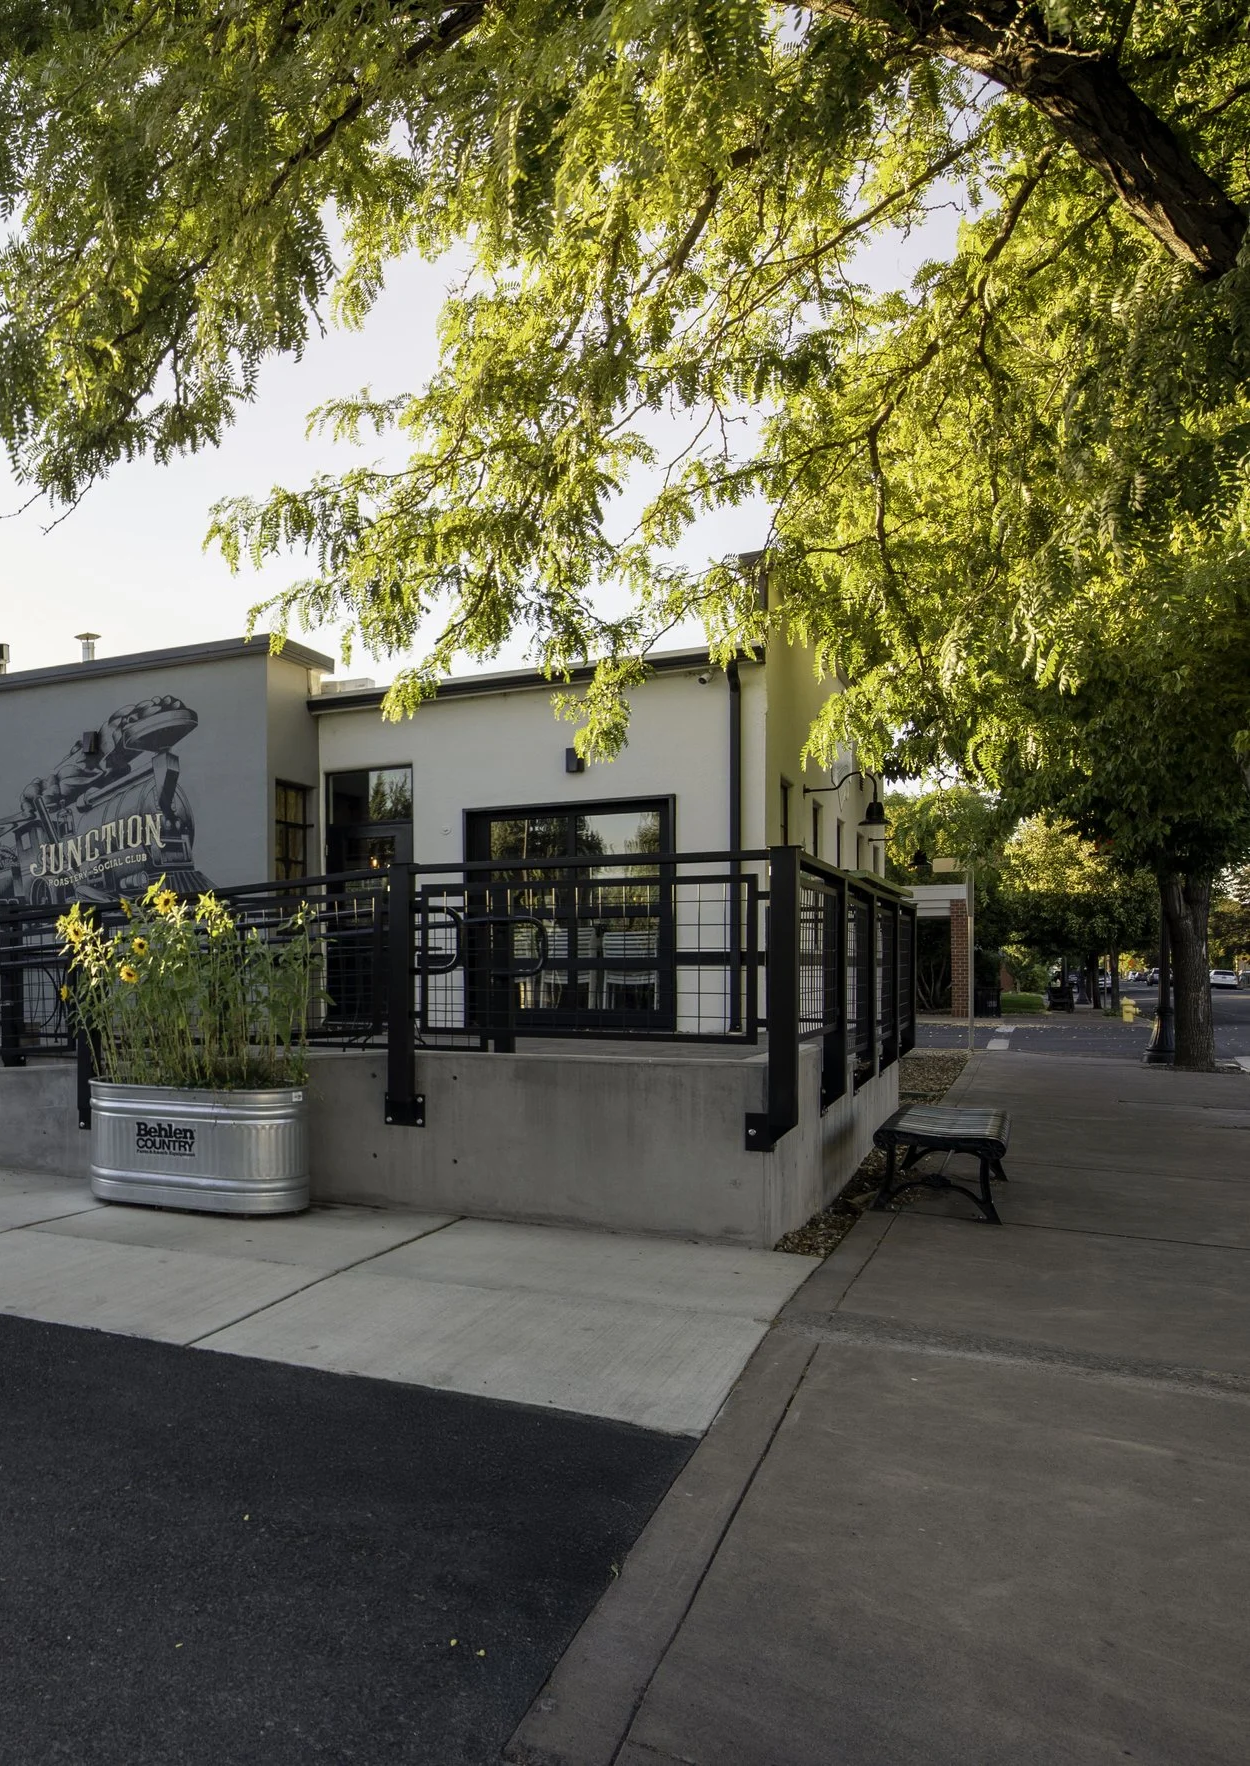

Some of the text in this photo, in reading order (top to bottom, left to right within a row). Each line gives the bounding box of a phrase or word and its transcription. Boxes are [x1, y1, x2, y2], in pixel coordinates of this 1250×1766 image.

[30, 813, 166, 877] JUNCTION
[47, 853, 147, 887] ROASTERY SOCIAL CLUB
[136, 1121, 195, 1140] Behlen
[136, 1137, 195, 1152] COUNTRY
